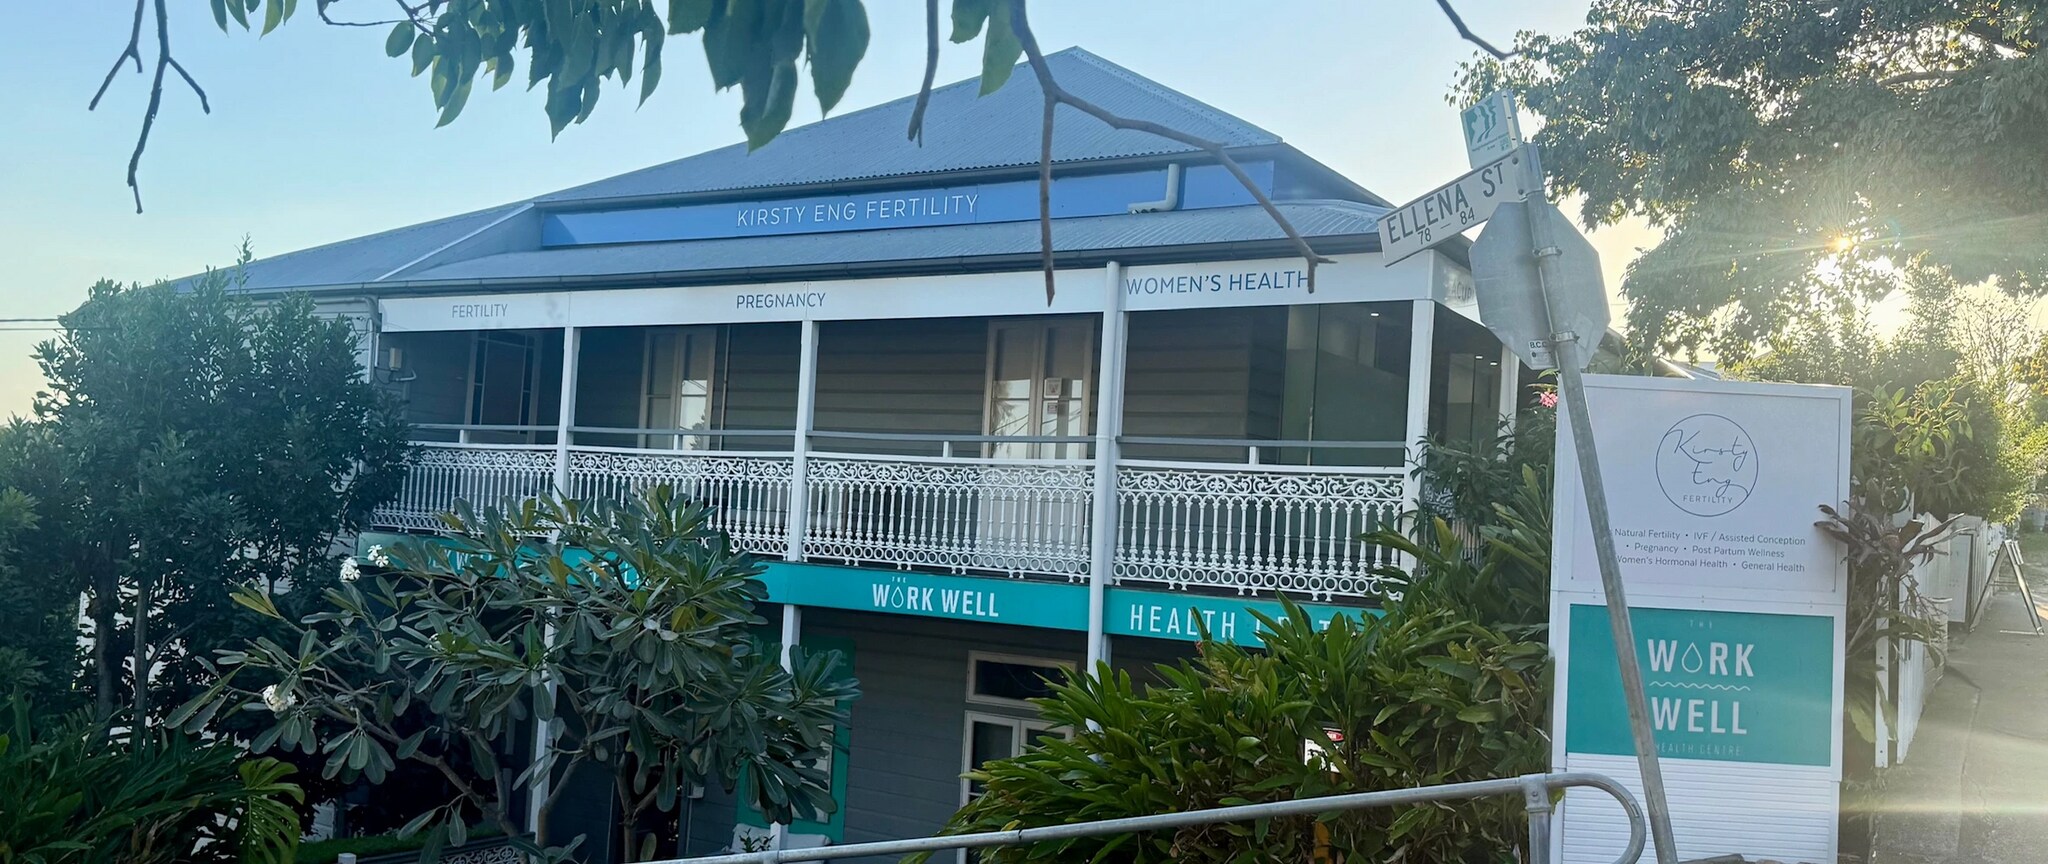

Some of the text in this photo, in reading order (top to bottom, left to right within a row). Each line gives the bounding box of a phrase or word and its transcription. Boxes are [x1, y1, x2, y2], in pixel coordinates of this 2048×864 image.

[736, 194, 979, 227] KIRSTY ENG FERTILITY
[1386, 162, 1504, 244] ELLENA ST
[1417, 228, 1432, 245] 78
[1459, 207, 1475, 225] 84
[1126, 271, 1311, 296] WOMEN'S HEALTH
[451, 304, 508, 319] FERTILITY
[736, 293, 827, 310] PREGNANCY
[1666, 429, 1748, 472] Kirsty
[1691, 461, 1747, 498] Eng
[1682, 494, 1733, 504] FERTILITY
[1614, 528, 1646, 538] Natural
[1648, 529, 1681, 540] Fertility
[1693, 532, 1709, 540] IVF
[1718, 533, 1755, 543] Assisted
[1757, 534, 1806, 546] Conception
[1634, 542, 1785, 558] Pregnancy Post Partum Wellness
[1655, 557, 1698, 567] Hormonal
[1699, 559, 1728, 569] Health
[1741, 560, 1775, 571] General
[1776, 562, 1806, 573] Health
[941, 589, 999, 617] WELL
[1130, 604, 1236, 639] HEALTH
[1651, 697, 1748, 735] WELL
